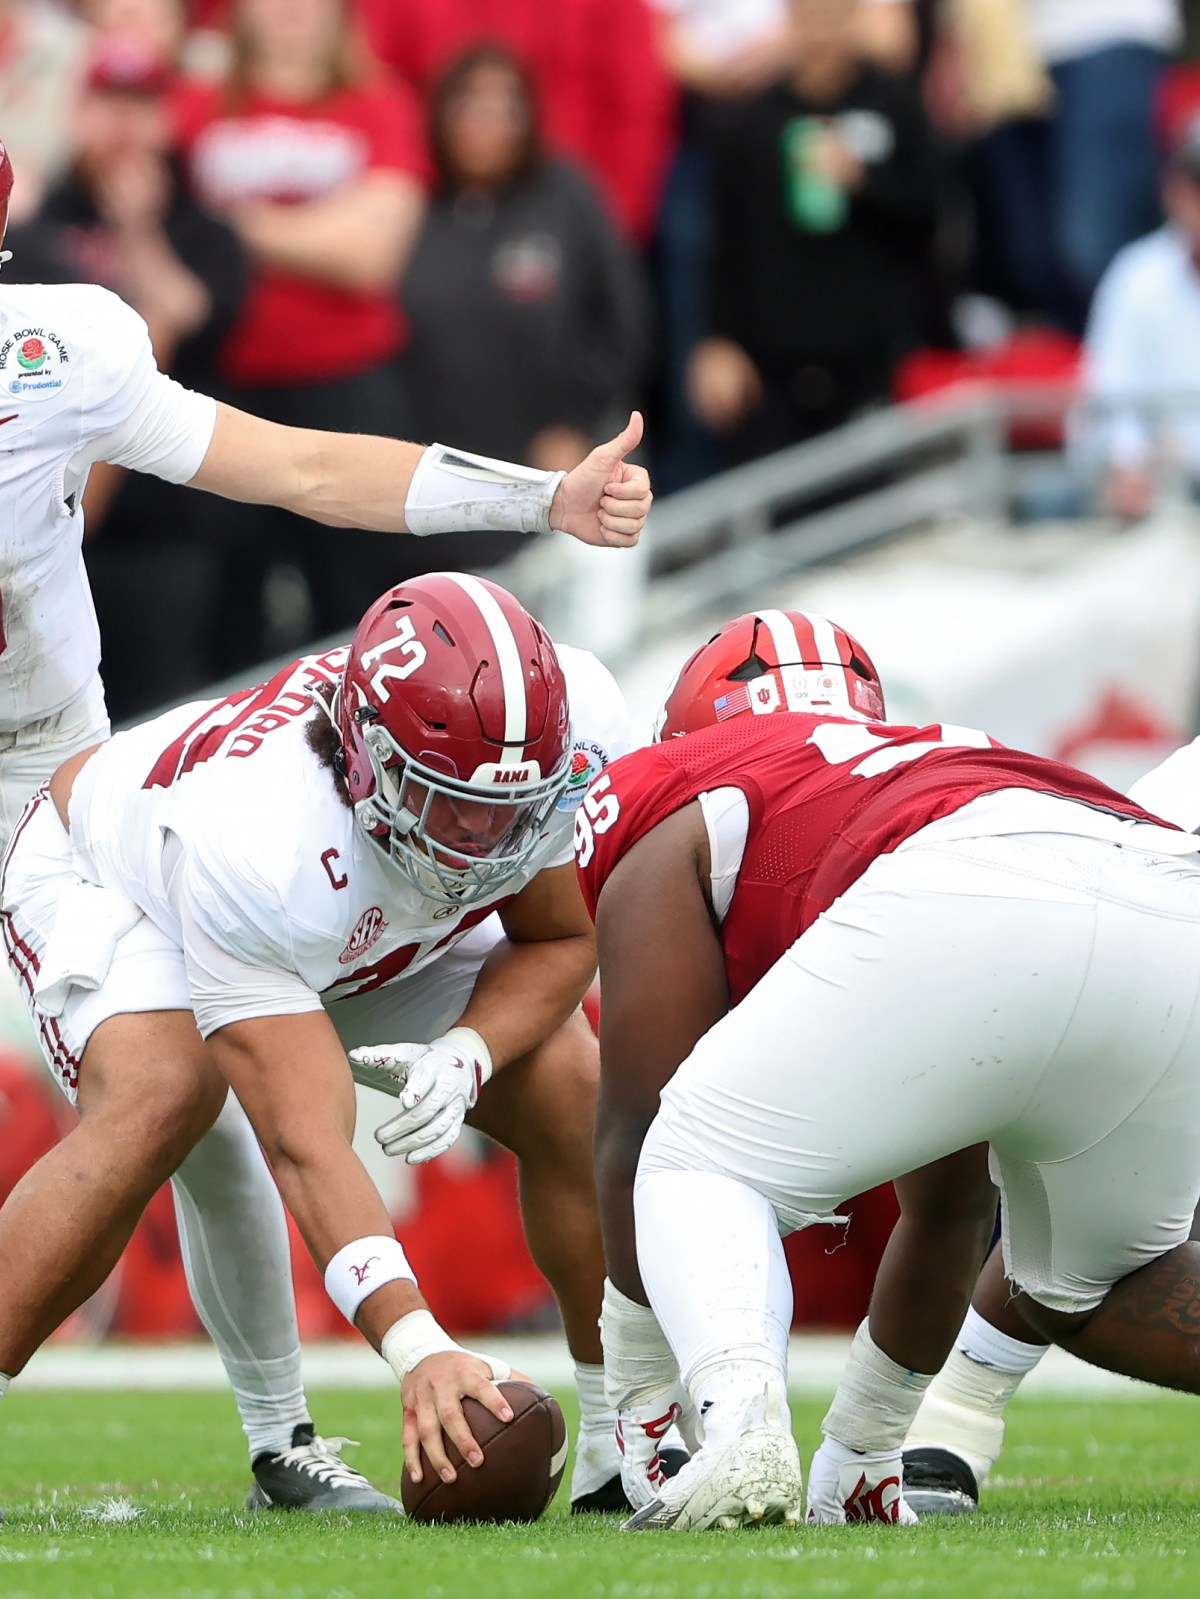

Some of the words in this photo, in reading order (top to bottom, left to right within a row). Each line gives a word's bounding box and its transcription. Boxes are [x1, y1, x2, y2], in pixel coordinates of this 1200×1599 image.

[13, 328, 46, 341] BOWL
[48, 333, 69, 363] GAME
[22, 380, 62, 391] Prudential
[361, 615, 427, 704] 72
[493, 769, 529, 783] BAMA
[573, 773, 621, 869] 95
[320, 846, 349, 892] C
[350, 907, 381, 949] SEC
